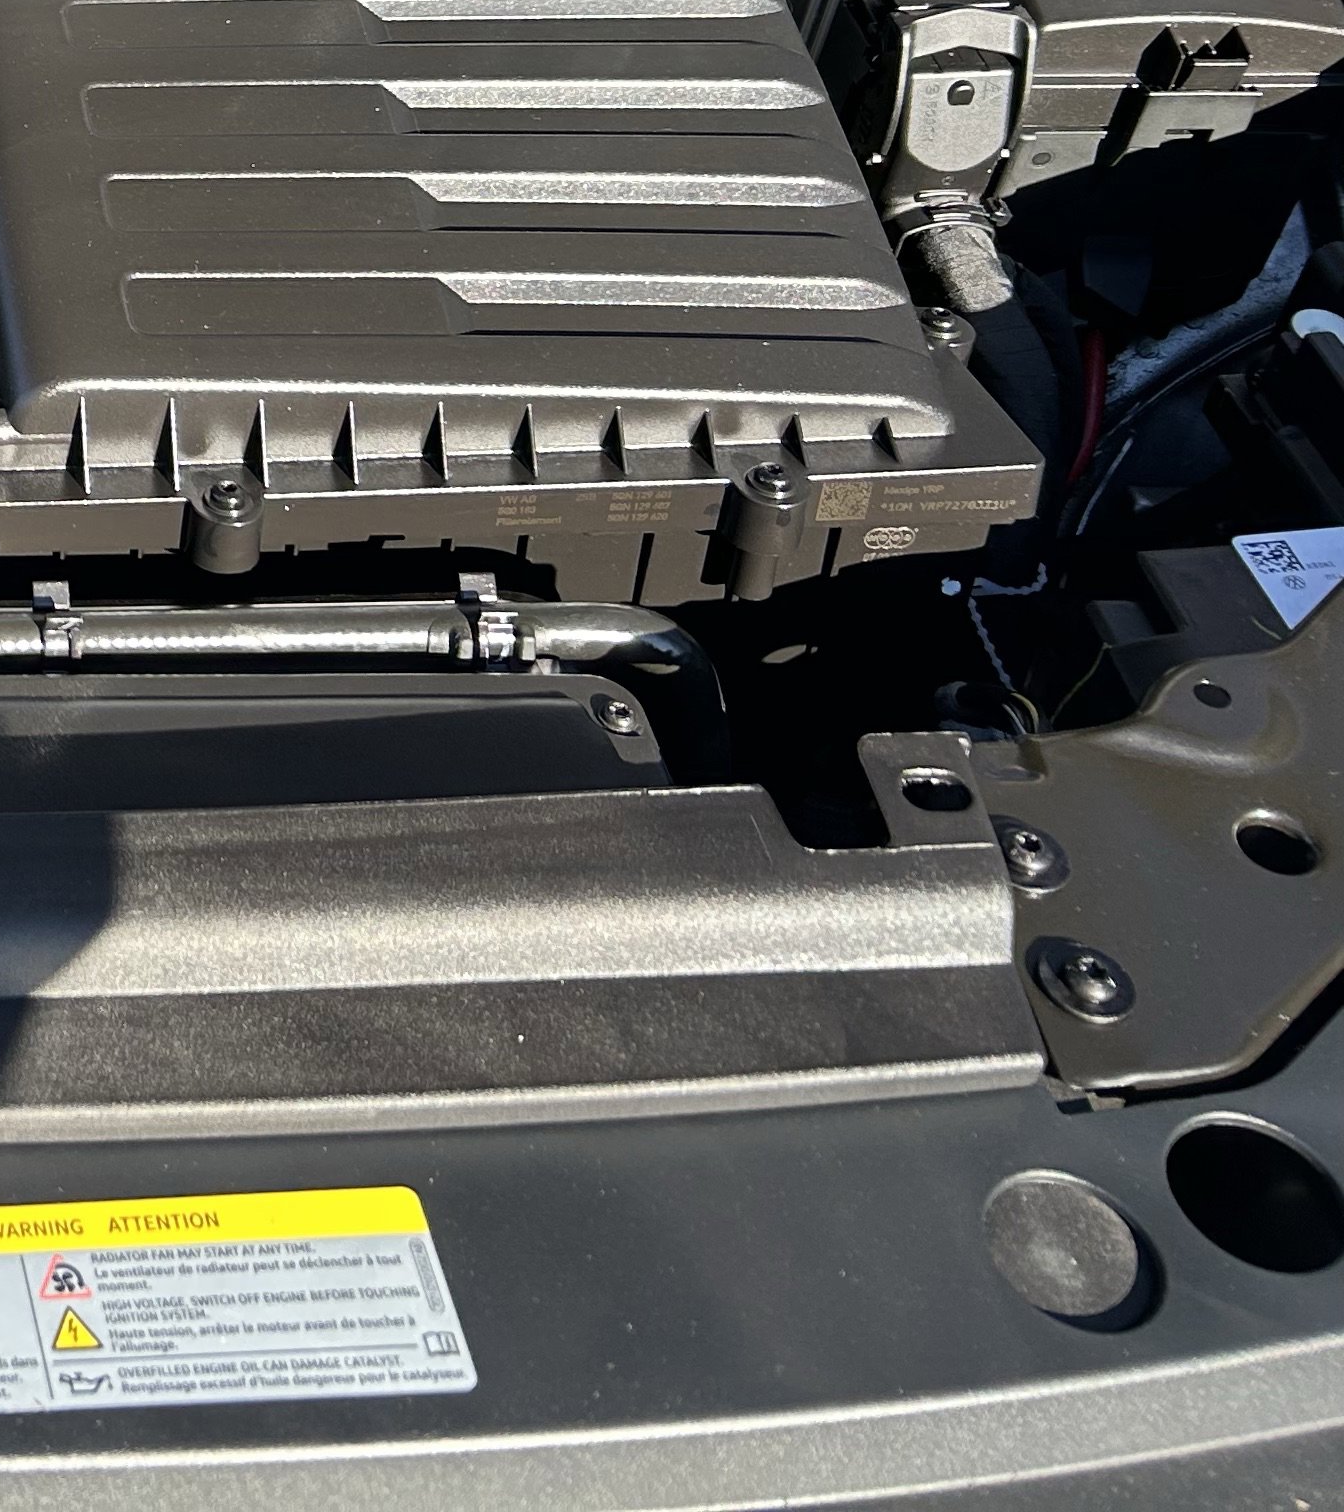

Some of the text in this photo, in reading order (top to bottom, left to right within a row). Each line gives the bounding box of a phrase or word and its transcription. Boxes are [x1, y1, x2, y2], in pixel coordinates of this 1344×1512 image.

[108, 1211, 220, 1233] ATTENTION
[91, 1242, 316, 1264] RADIATOR FAN MAY START AT ANY TIME.
[94, 1267, 109, 1279] Le
[111, 1264, 175, 1278] ventilateur
[178, 1262, 193, 1275] de
[196, 1261, 249, 1274] radiateur
[253, 1260, 280, 1273] peut
[283, 1260, 296, 1269] se
[366, 1254, 373, 1266] à
[376, 1254, 402, 1266] tout
[98, 1280, 152, 1292] moment.
[102, 1300, 131, 1311] HIGH
[191, 1293, 236, 1307] SWITCH
[238, 1292, 260, 1305] OFF
[263, 1290, 306, 1303] ENGINE
[309, 1287, 356, 1301] BEFORE
[359, 1285, 420, 1299] TOUCHING
[105, 1309, 209, 1324] IGNITION SYSTEM.
[108, 1327, 146, 1339] Haute
[242, 1321, 254, 1333] le
[257, 1320, 300, 1333] moteur
[304, 1319, 338, 1332] avant
[341, 1316, 356, 1329] de
[358, 1314, 405, 1329] toucher
[408, 1314, 416, 1326] à
[11, 1354, 39, 1367] dans
[118, 1363, 191, 1379] OVERFILLED
[193, 1361, 238, 1375] ENGINE
[241, 1360, 260, 1372] OIL
[263, 1359, 288, 1371] CAN
[291, 1356, 341, 1369] DAMAGE
[121, 1379, 197, 1395] Remplissage
[358, 1372, 386, 1386] pour
[388, 1369, 400, 1382] le
